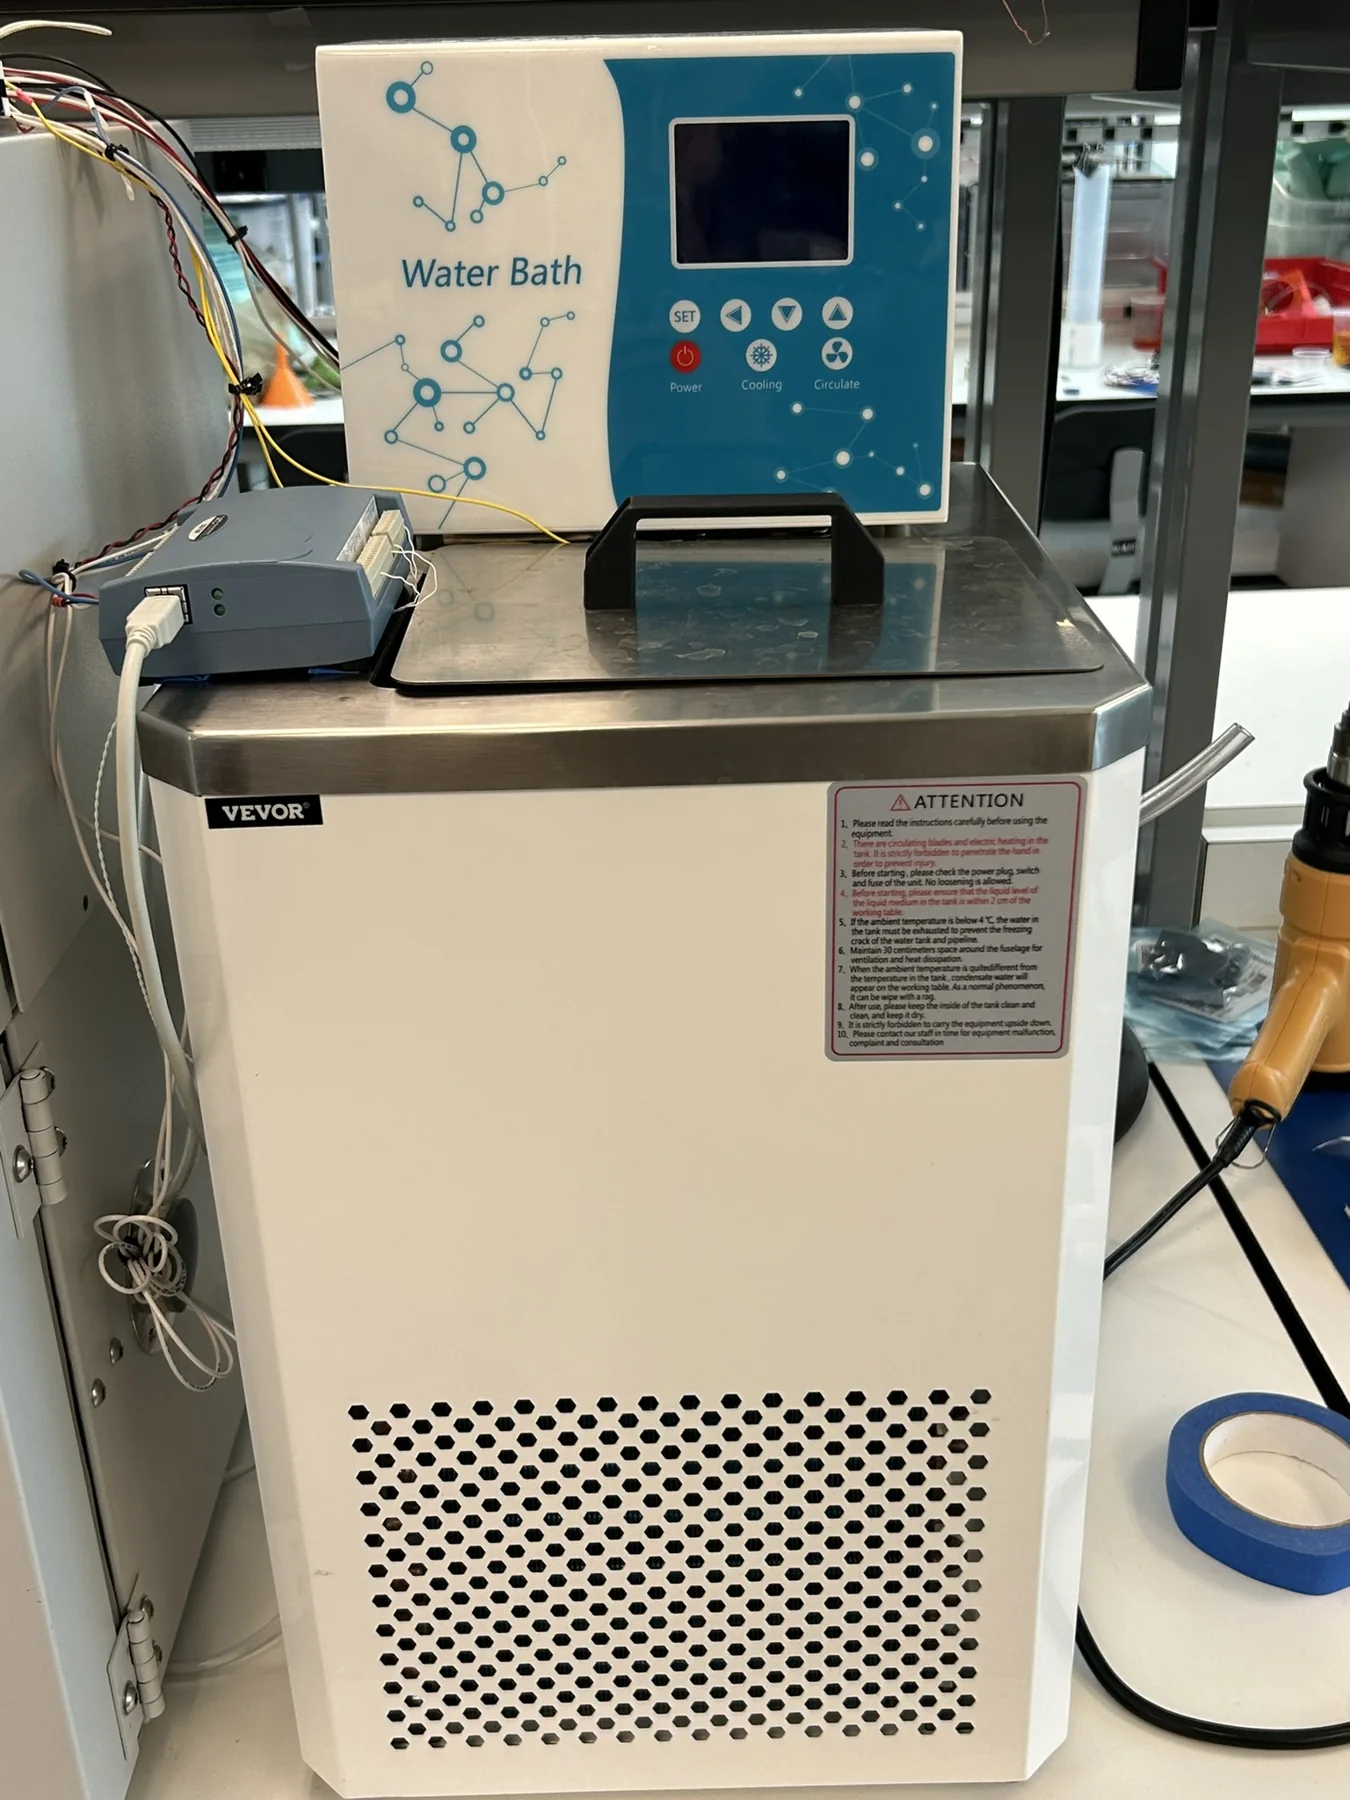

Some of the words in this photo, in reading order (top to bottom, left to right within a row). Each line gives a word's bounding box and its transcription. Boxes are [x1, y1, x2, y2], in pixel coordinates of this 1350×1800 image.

[402, 258, 499, 288] Water
[510, 254, 582, 286] Bath
[674, 310, 696, 323] SET
[670, 382, 702, 393] Power
[741, 379, 782, 392] Cooling
[814, 379, 860, 390] Circulate
[913, 793, 1023, 809] ATTENTION
[853, 819, 876, 827] Please
[878, 819, 894, 827] read
[896, 818, 908, 826] the
[910, 818, 952, 826] instructions
[954, 817, 985, 827] carefully
[987, 817, 1011, 825] before
[1012, 817, 1033, 827] using
[1035, 816, 1048, 824] the
[852, 869, 875, 877] Before
[910, 868, 934, 878] please
[935, 868, 956, 876] check
[957, 868, 970, 876] the
[971, 868, 994, 877] power
[1015, 866, 1040, 875] switch
[852, 879, 866, 887] and
[867, 879, 883, 887] fuse
[925, 878, 936, 886] No
[938, 878, 973, 887] loosening
[902, 917, 946, 926] temperature
[996, 916, 1008, 924] the
[960, 927, 988, 936] prevent
[989, 926, 1002, 934] the
[1002, 926, 1032, 935] freezing
[871, 937, 879, 945] of
[880, 937, 892, 945] the
[937, 947, 958, 955] space
[959, 945, 985, 953] around
[986, 945, 998, 953] the
[1000, 945, 1030, 954] fuselage
[850, 965, 870, 973] When
[916, 964, 961, 974] temperature
[1020, 963, 1037, 971] from
[863, 975, 908, 984] temperature
[951, 973, 993, 981] condensate
[994, 973, 1013, 981] water
[1015, 972, 1028, 980] will
[900, 984, 929, 993] working
[881, 994, 898, 1003] wipe
[883, 1002, 906, 1011] please
[908, 1002, 925, 1011] keep
[939, 1001, 960, 1009] inside
[970, 1001, 982, 1009] the
[984, 1001, 999, 1009] tank
[1000, 1001, 1020, 1009] clean
[886, 1011, 903, 1021] keep
[862, 1021, 886, 1030] strictly
[887, 1020, 922, 1028] forbidden
[932, 1021, 950, 1029] carry
[964, 1020, 1003, 1029] equipment
[1004, 1019, 1028, 1029] upside
[943, 1029, 959, 1037] time
[960, 1029, 970, 1037] for
[971, 1029, 1010, 1038] equipment
[849, 1040, 884, 1049] complaint
